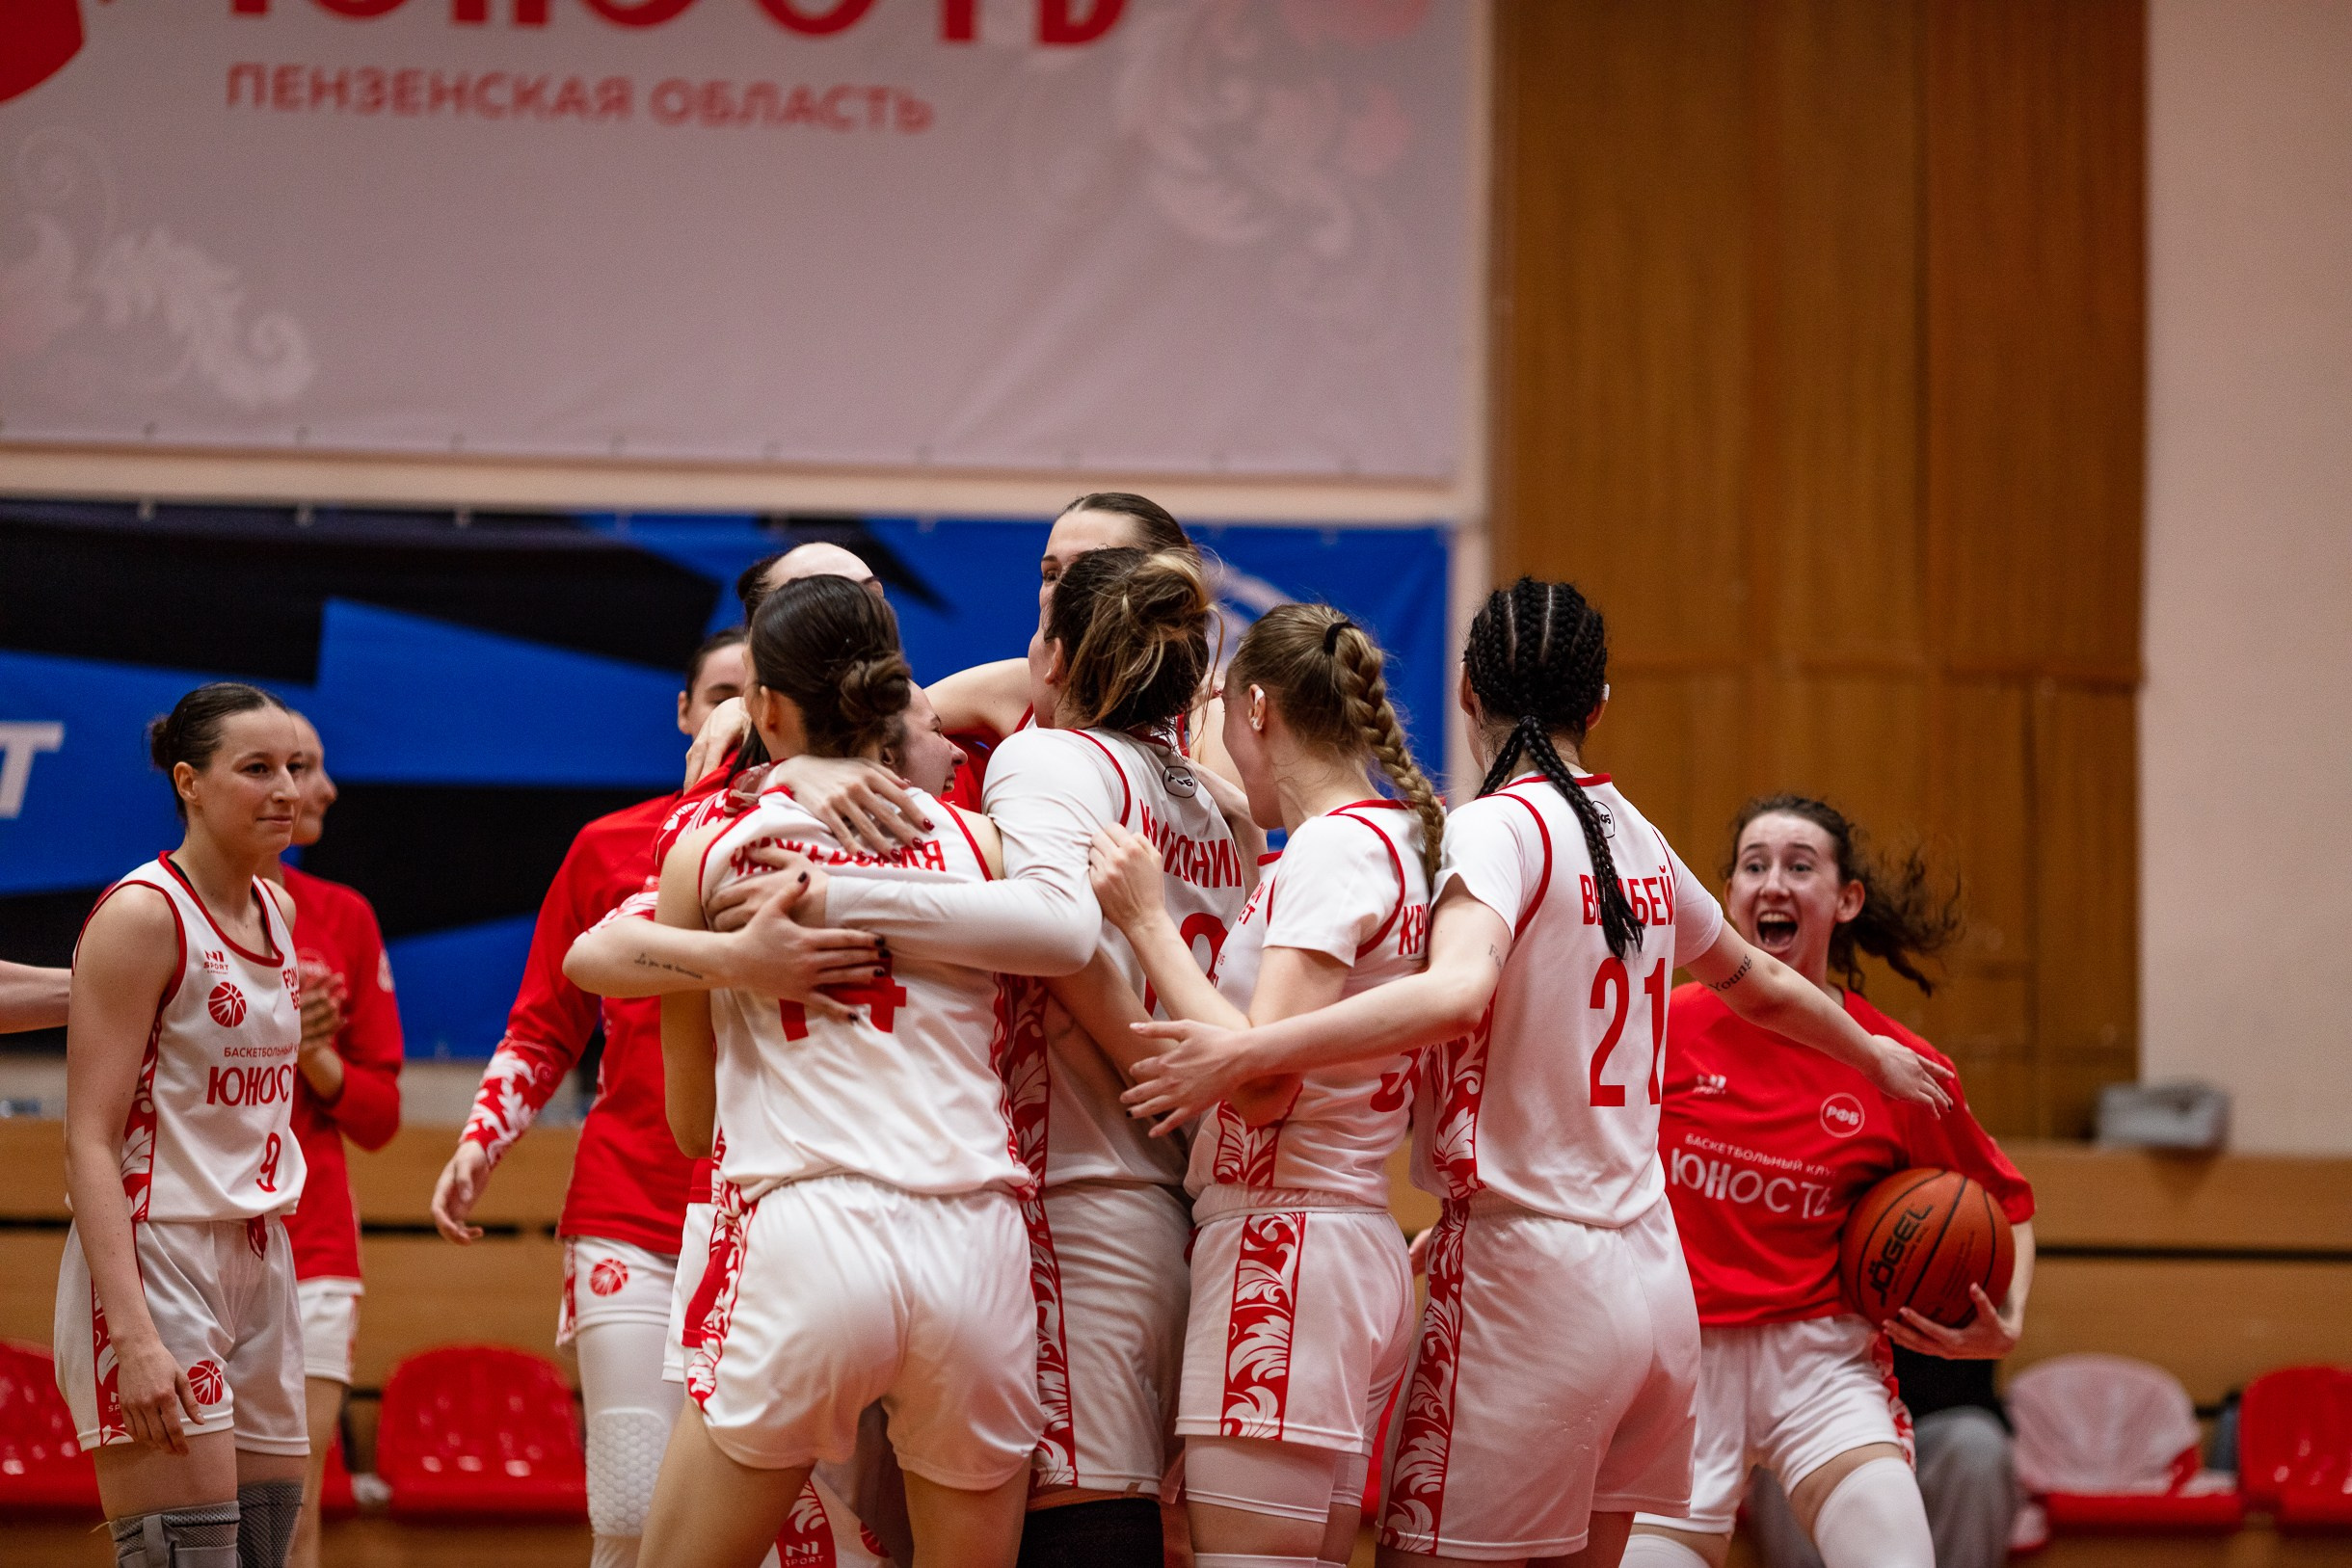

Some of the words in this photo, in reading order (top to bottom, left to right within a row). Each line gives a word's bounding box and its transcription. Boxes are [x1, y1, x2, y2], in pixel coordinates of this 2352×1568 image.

[227, 63, 633, 122] ПЕНЗЕНСКАЯ
[650, 78, 935, 133] ОБЛАСТЬ
[1708, 952, 1753, 993] Young
[1589, 956, 1666, 1107] 21
[1826, 1104, 1860, 1127] РФБ
[255, 1131, 281, 1193] 9
[1670, 1147, 1831, 1219] ЮНОСТЬ
[1685, 1132, 1804, 1172] БАСКЕТБОЛЬНЫЙ
[1867, 1205, 1934, 1308] JÖGEL
[785, 1555, 824, 1567] SPORT
